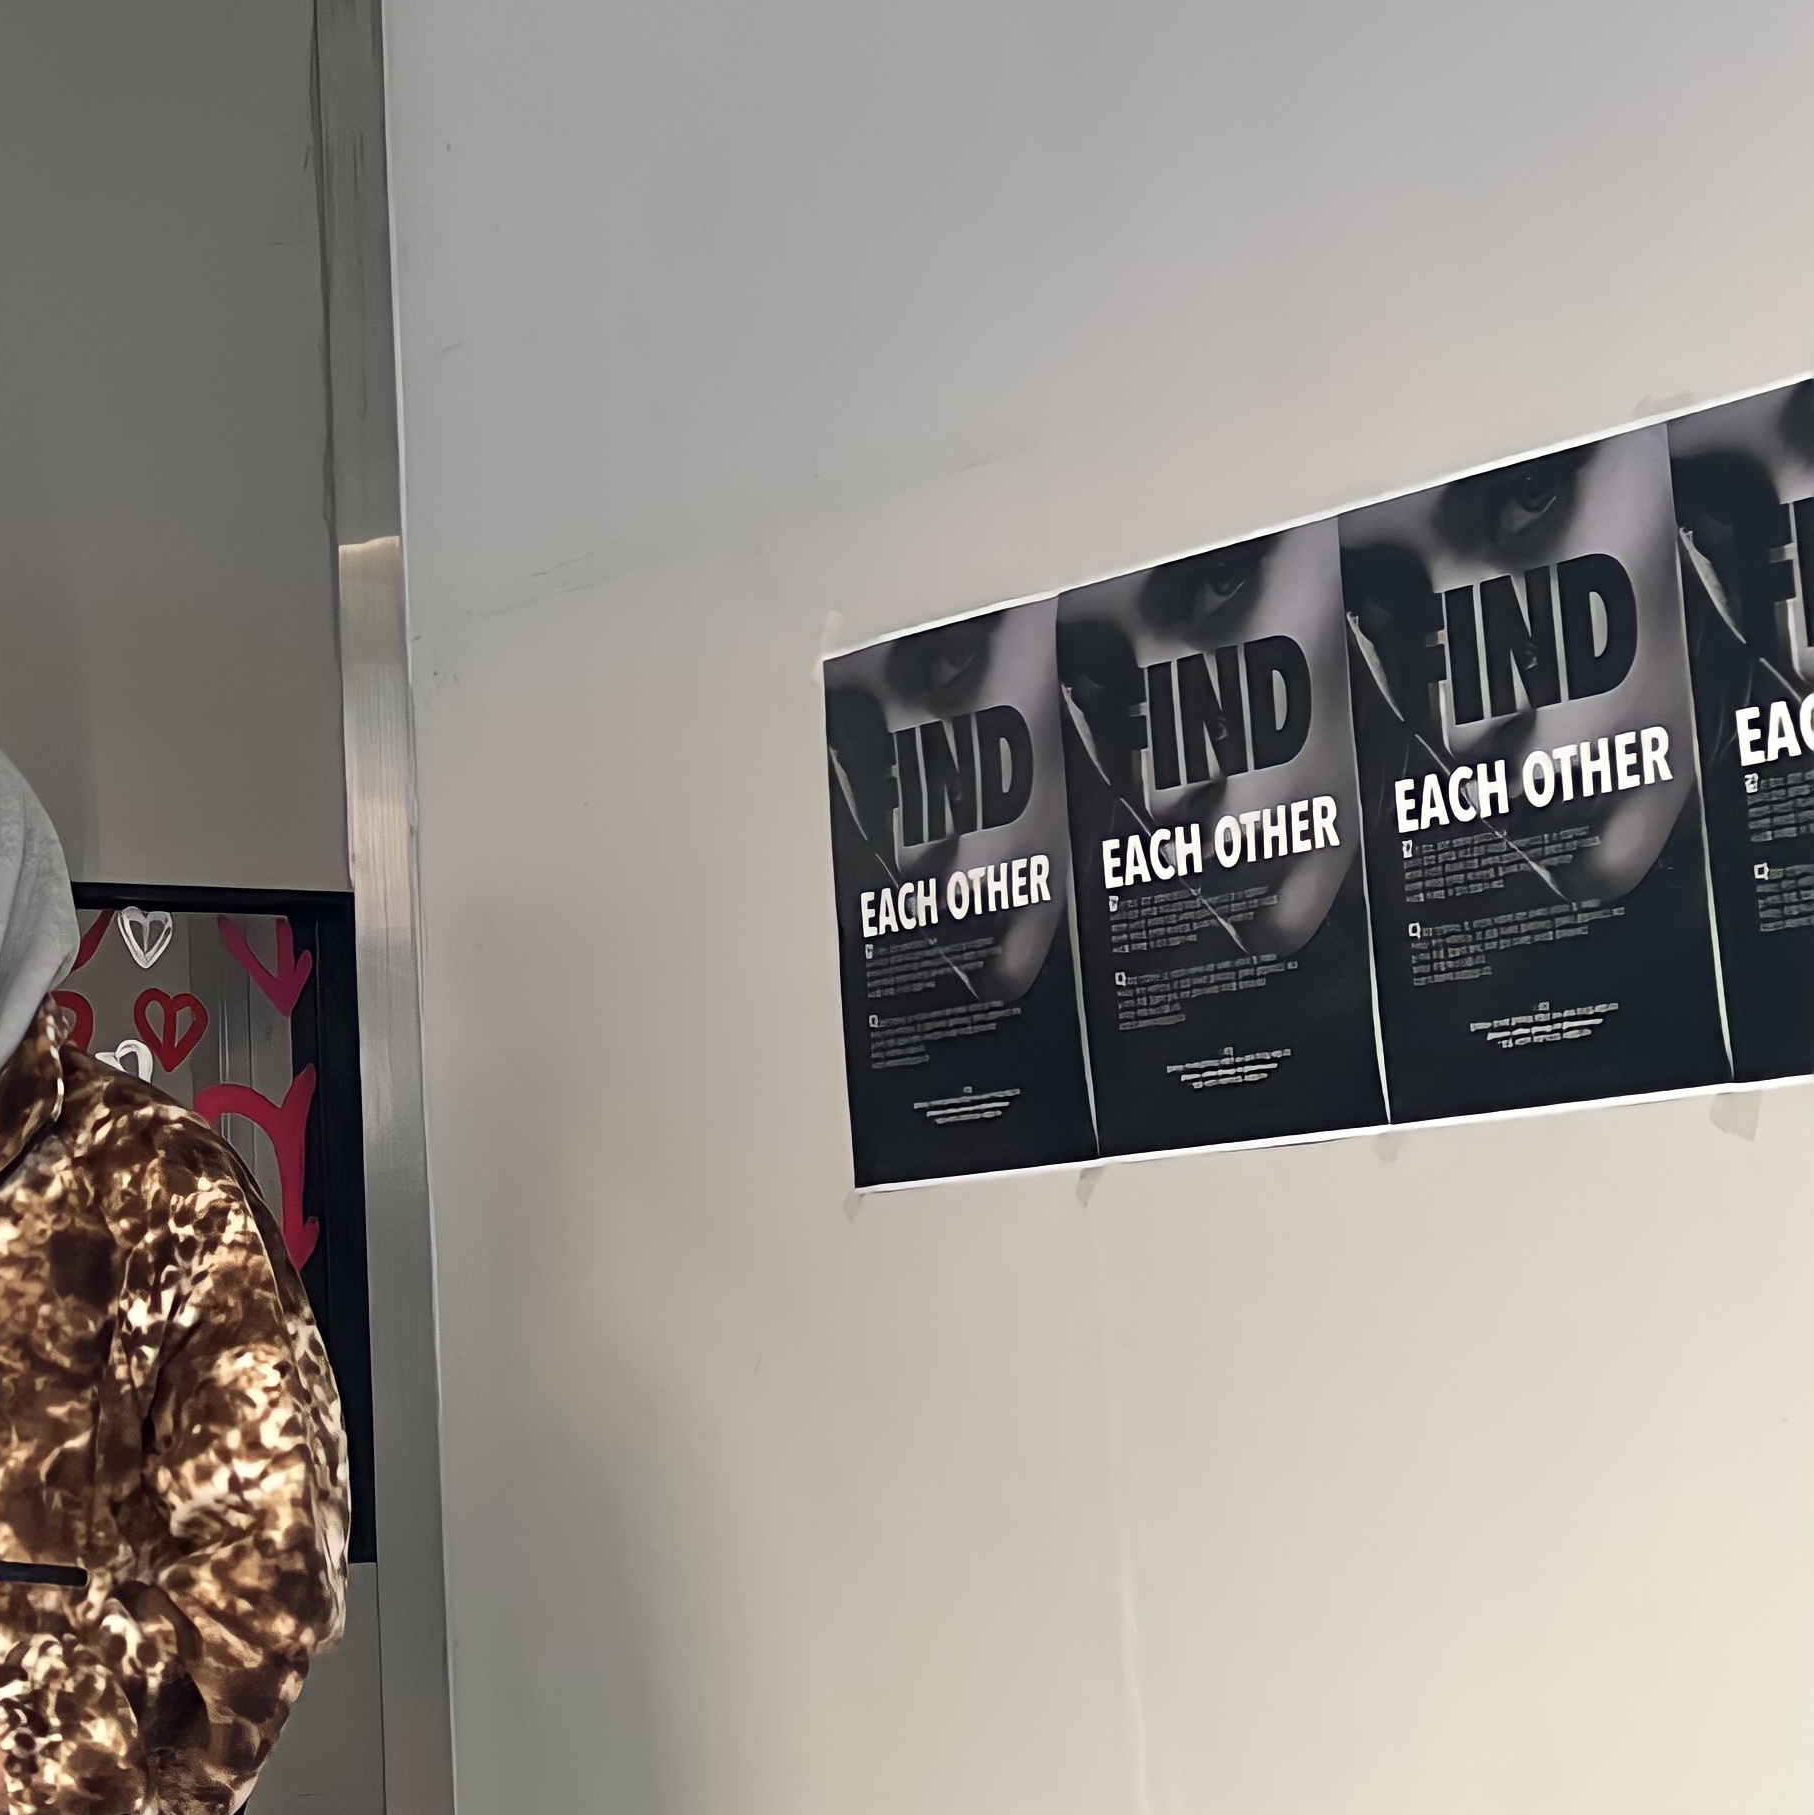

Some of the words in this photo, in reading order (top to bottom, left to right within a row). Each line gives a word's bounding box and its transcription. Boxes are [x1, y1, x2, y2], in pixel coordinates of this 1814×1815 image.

[1394, 759, 1509, 833] EACH
[1522, 726, 1674, 809] OTHER
[1102, 823, 1203, 889] EACH
[1214, 795, 1341, 868] OTHER
[860, 878, 939, 938] EACH
[946, 854, 1052, 921] OTHER
